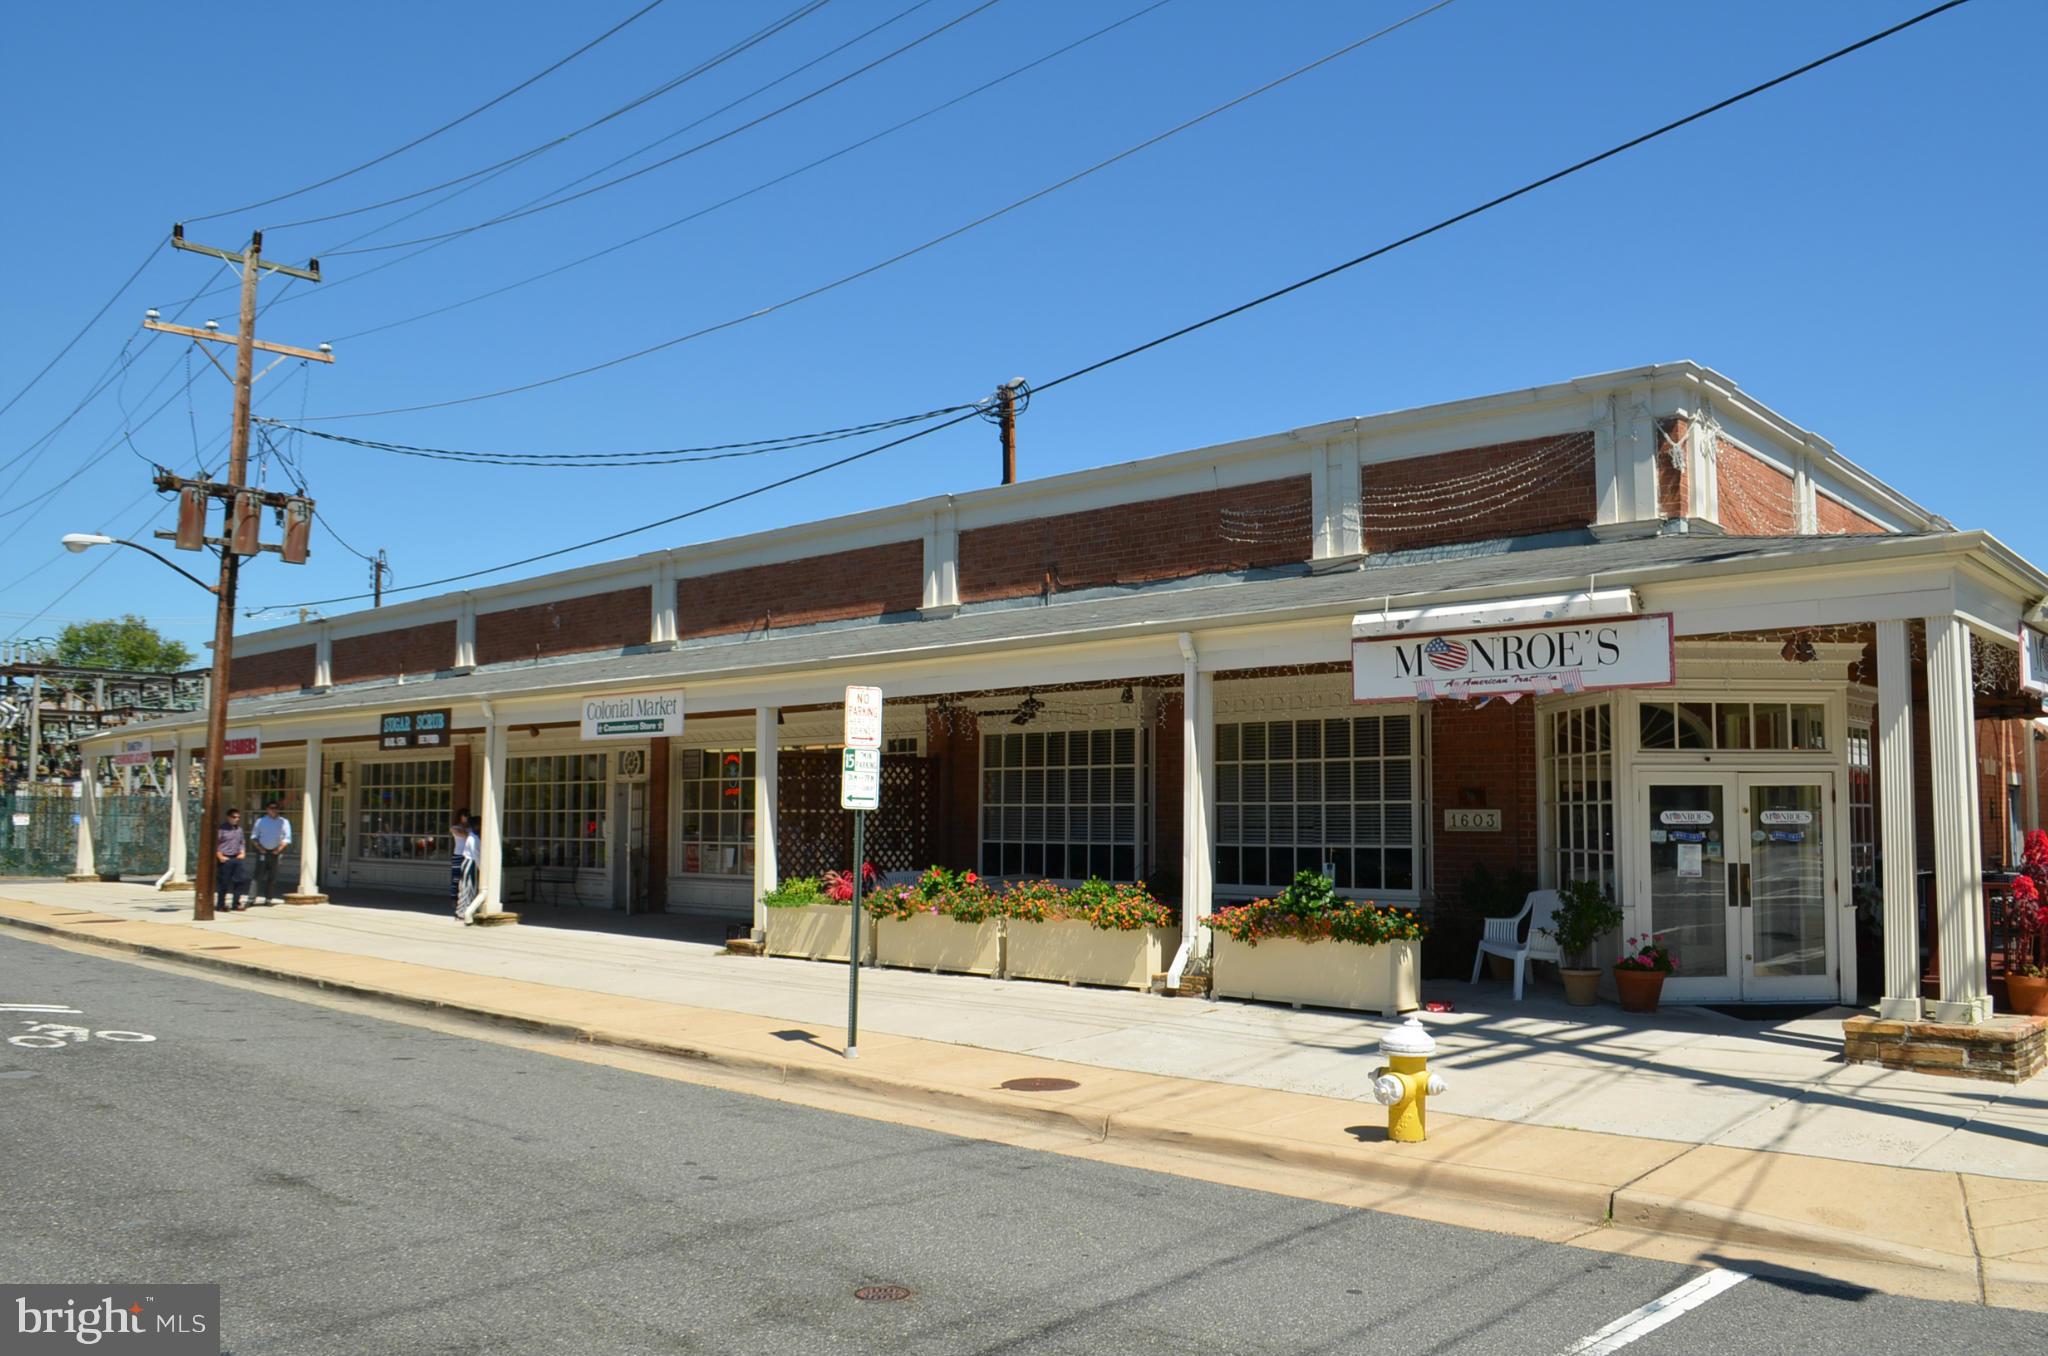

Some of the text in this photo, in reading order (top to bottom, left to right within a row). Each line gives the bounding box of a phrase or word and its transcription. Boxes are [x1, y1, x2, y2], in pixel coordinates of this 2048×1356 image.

[1393, 627, 1621, 679] MONROE'S
[1462, 677, 1508, 688] American
[856, 693, 870, 705] NO
[586, 695, 677, 721] Colonial Market
[848, 705, 879, 719] PARKING
[383, 713, 444, 733] SUGAR SCRUB
[639, 720, 657, 731] Store
[855, 760, 878, 769] PARKING
[1450, 814, 1495, 828] 1603
